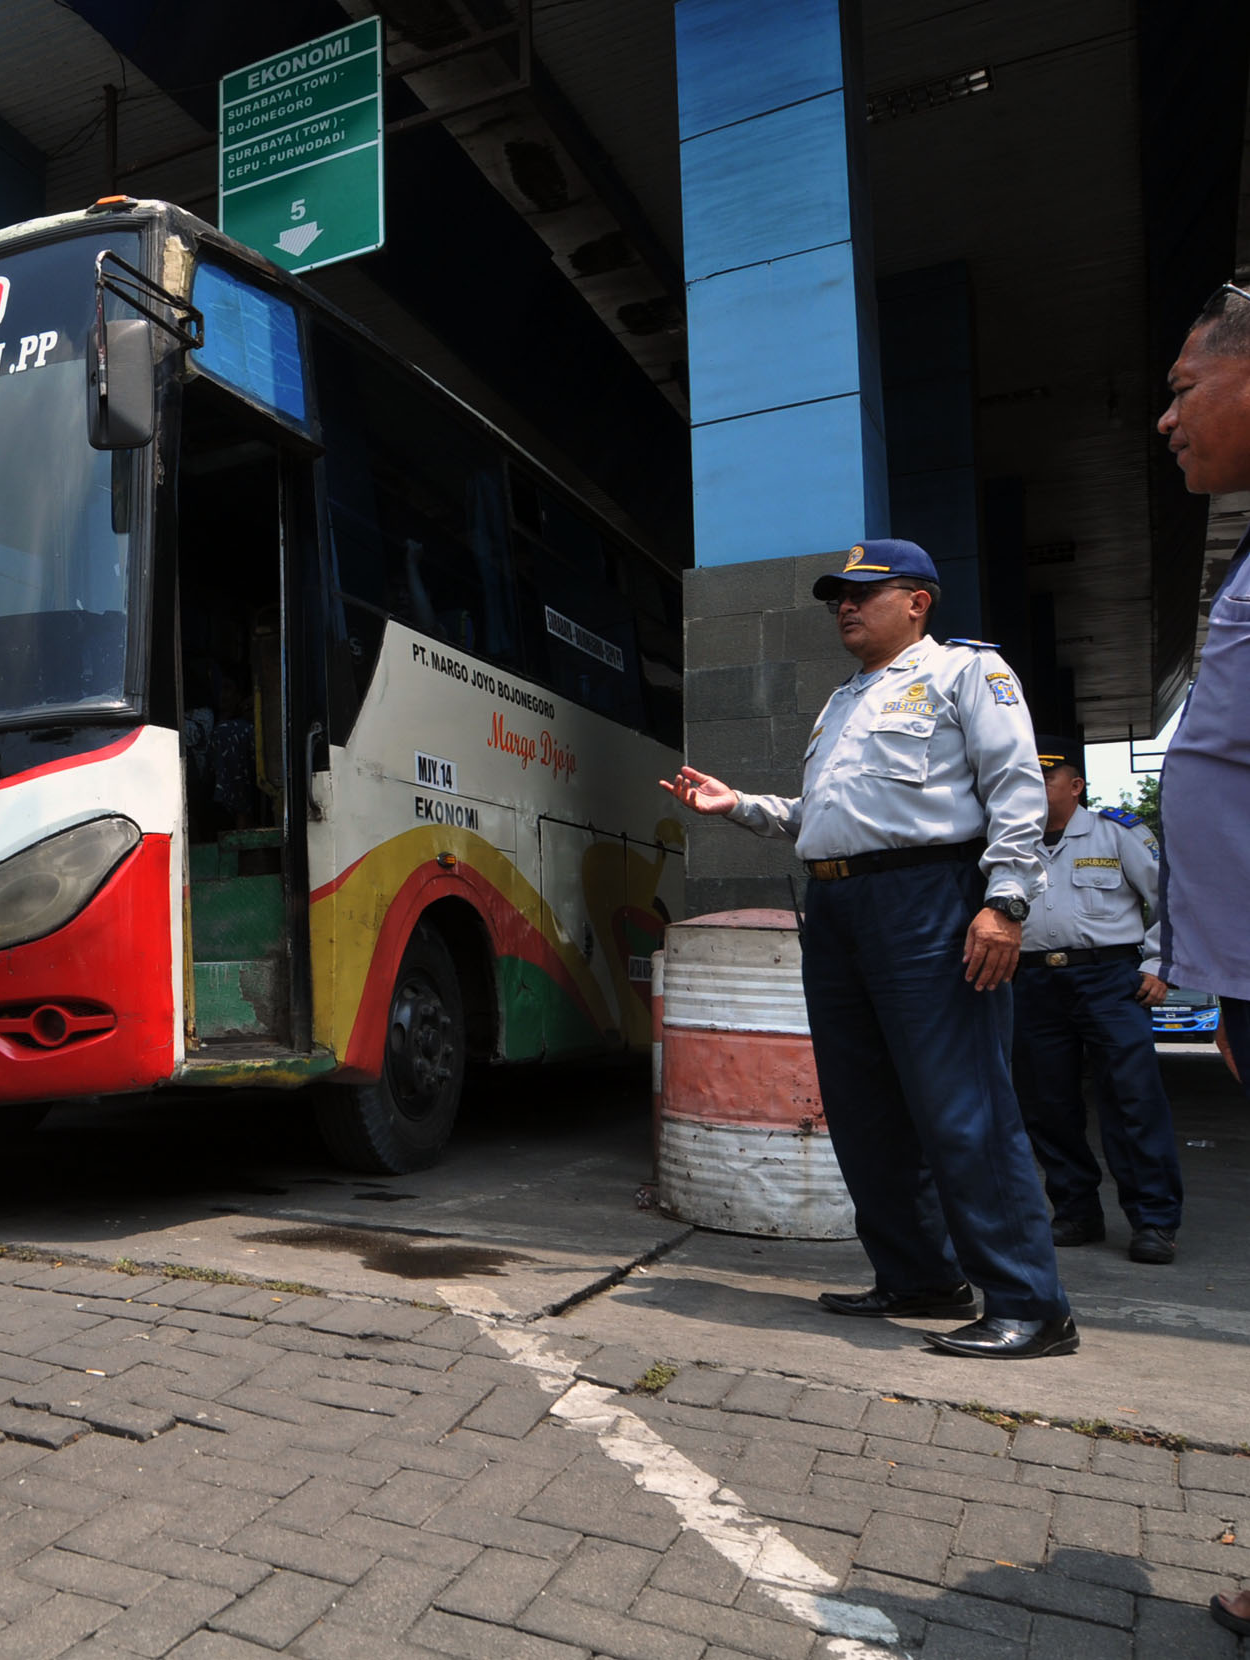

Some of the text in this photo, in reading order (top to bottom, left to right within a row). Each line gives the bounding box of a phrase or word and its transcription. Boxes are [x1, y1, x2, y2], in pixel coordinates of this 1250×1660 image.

[247, 36, 351, 90] EKONOMI
[227, 88, 292, 121] SURABAYA
[302, 73, 330, 92] TOW
[227, 96, 313, 136] BOJONEGORO
[227, 131, 292, 164] SURABAYA
[302, 117, 330, 136] TOW
[227, 153, 260, 180] CEPU
[269, 130, 346, 166] PURWODADI
[290, 199, 306, 221] 5
[412, 643, 555, 720] PT. MARGO JOYO BOJONEGORO
[487, 711, 578, 784] Margo Djojo
[414, 796, 479, 831] EKONOMI
